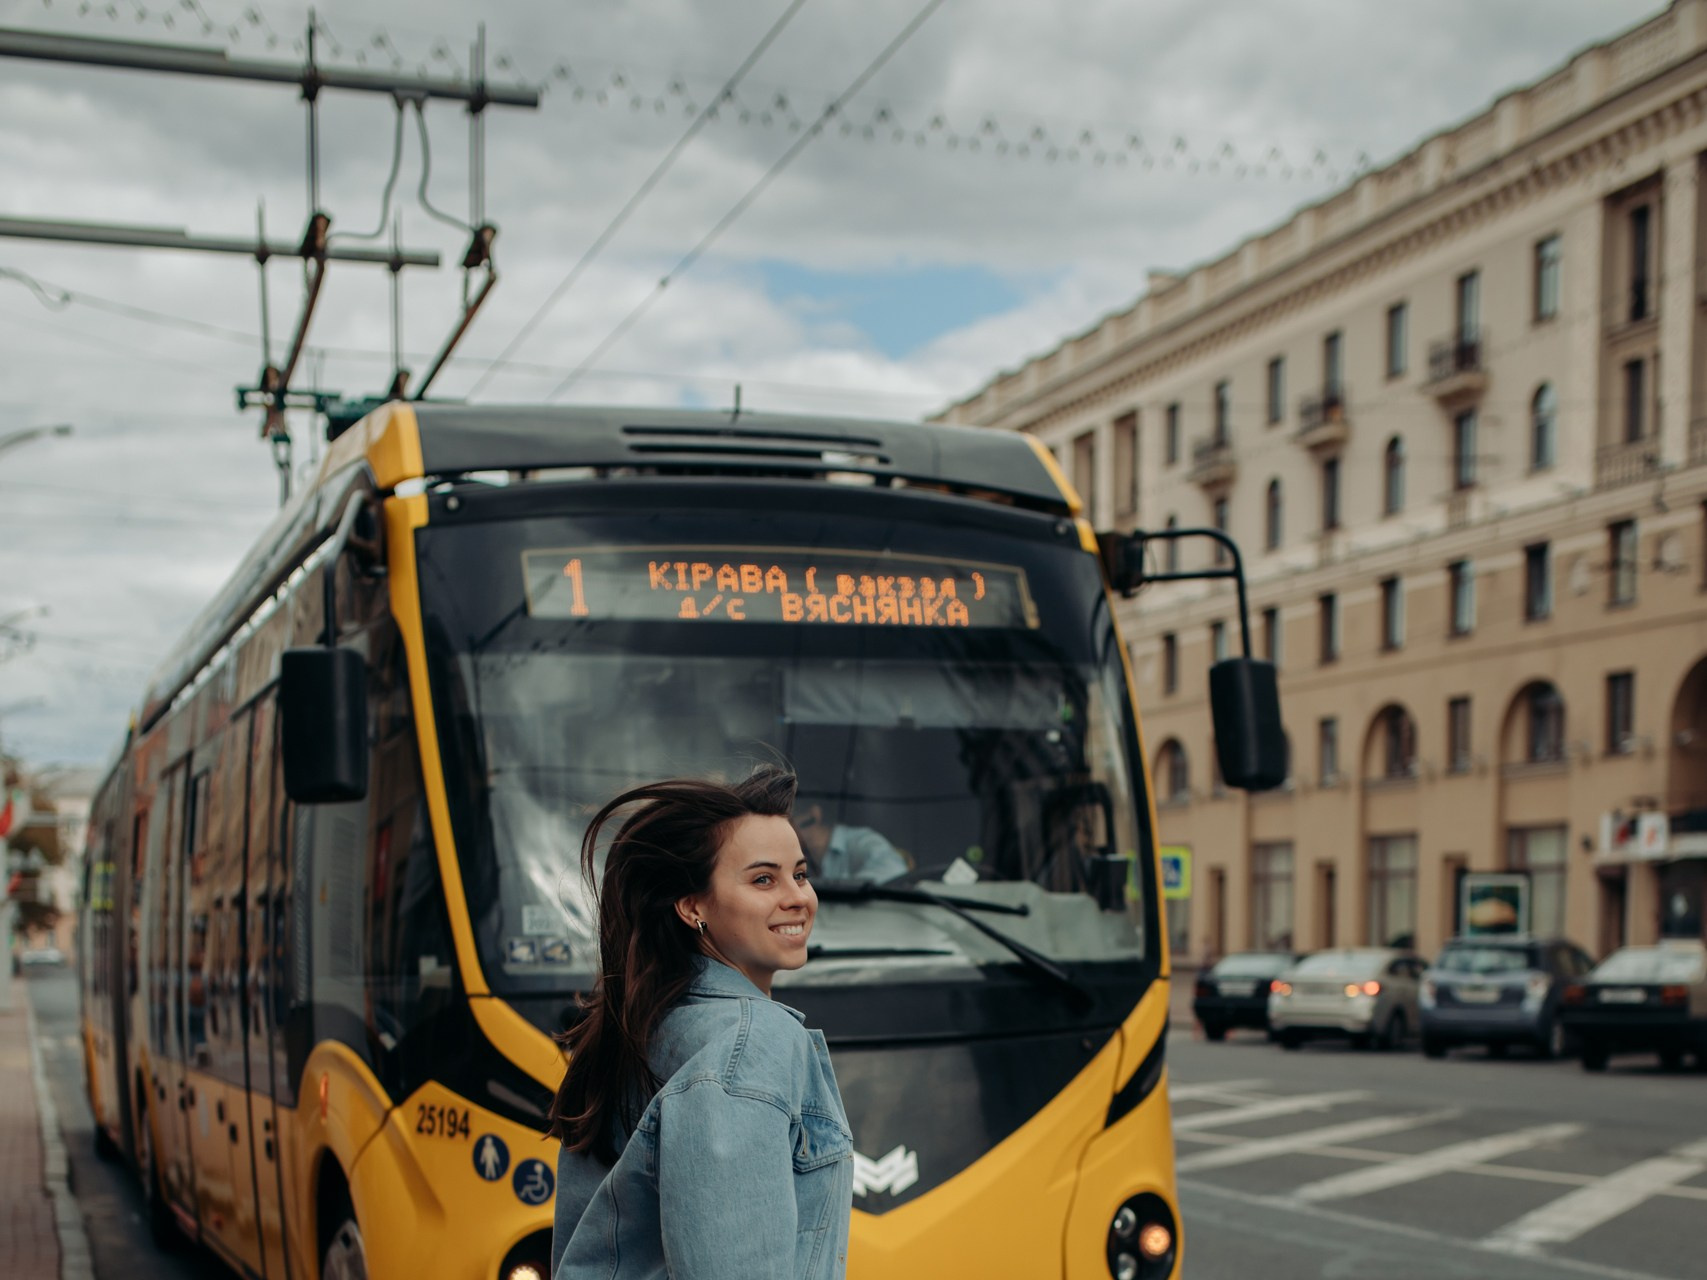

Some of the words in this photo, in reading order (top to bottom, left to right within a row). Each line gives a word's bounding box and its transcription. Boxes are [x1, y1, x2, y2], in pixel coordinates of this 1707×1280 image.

[563, 558, 589, 616] 1
[648, 561, 788, 593] КІРАВА
[781, 592, 969, 627] ВЯСНЯНКА
[416, 1104, 470, 1138] 25194
